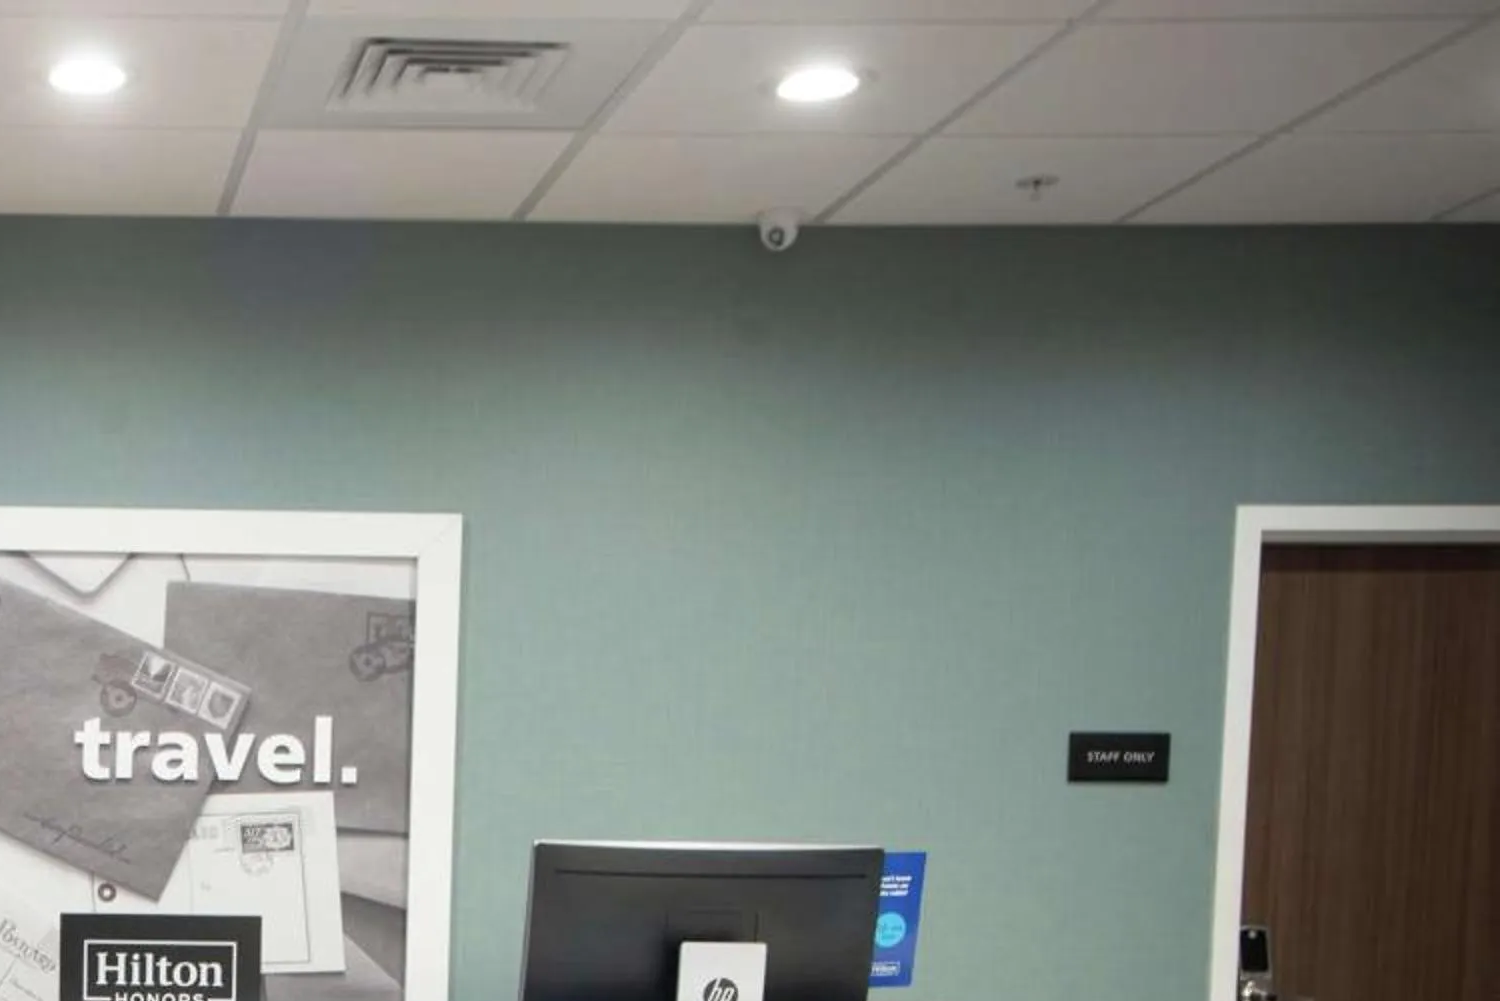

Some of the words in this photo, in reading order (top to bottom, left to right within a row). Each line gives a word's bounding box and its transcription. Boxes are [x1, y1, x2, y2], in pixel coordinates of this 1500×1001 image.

[74, 715, 357, 784] travel.
[1087, 751, 1120, 763] STAFF
[1124, 751, 1155, 763] ONLY
[95, 951, 224, 987] Hilton
